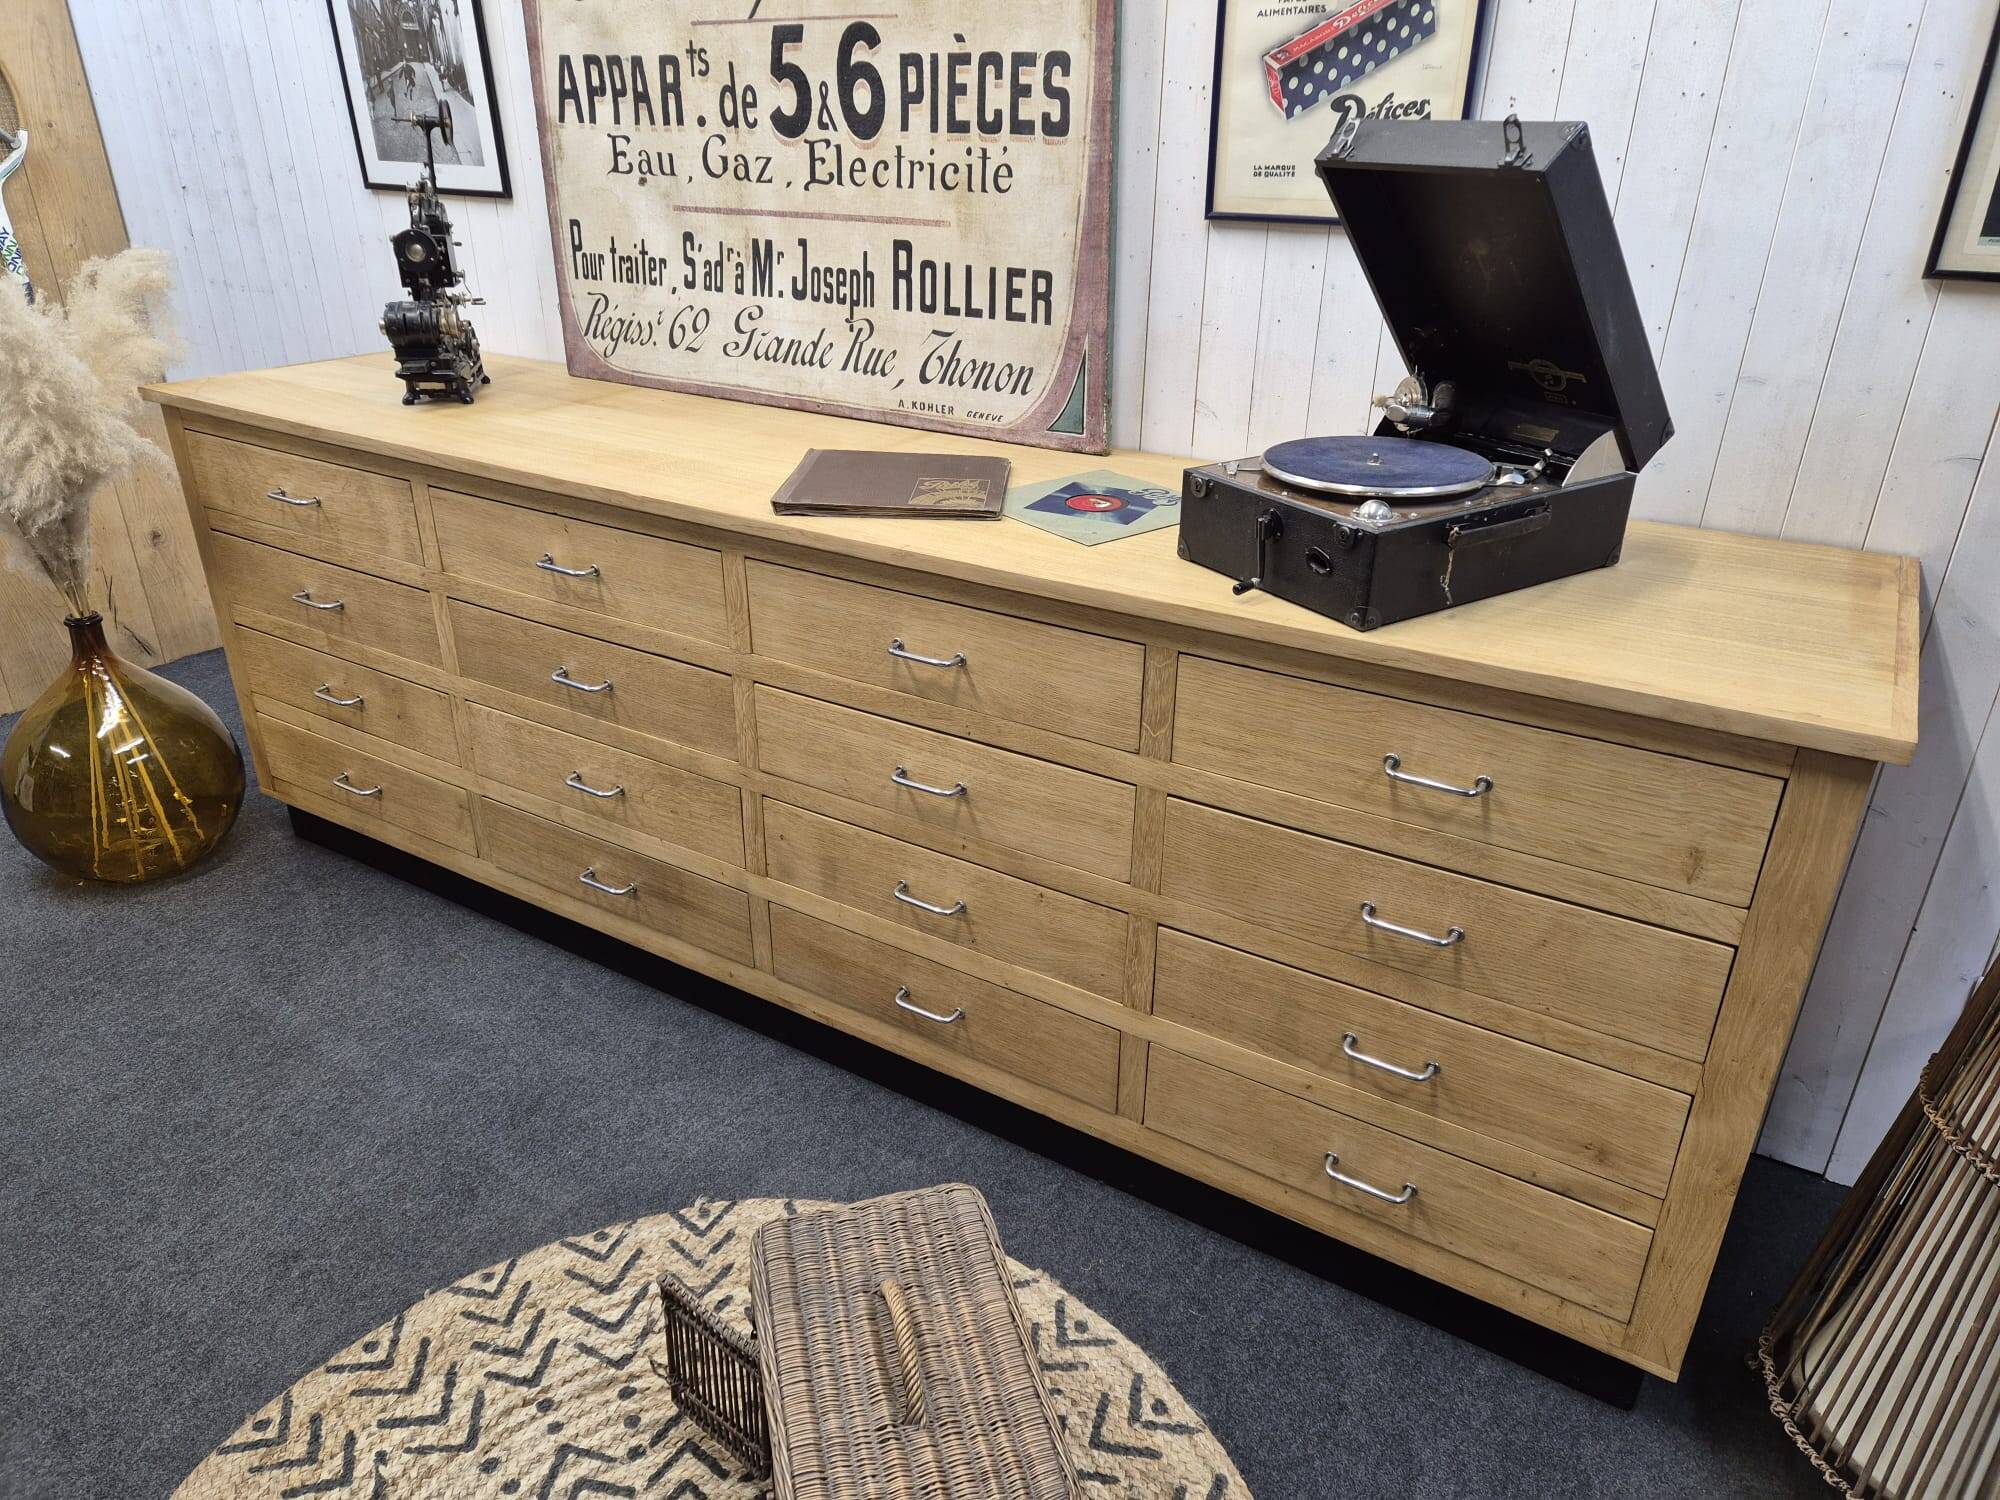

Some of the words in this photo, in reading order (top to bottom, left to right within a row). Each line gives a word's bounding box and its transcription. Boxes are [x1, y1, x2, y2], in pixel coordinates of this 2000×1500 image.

[1257, 5, 1327, 17] ALIMENTAIRES
[719, 61, 758, 129] de
[899, 33, 1072, 138] PIÈCES
[803, 138, 1014, 194] Electricité
[568, 219, 605, 281] Pour
[791, 237, 875, 333] Joseph
[892, 239, 1054, 326] ROLLIER
[668, 305, 711, 353] 62
[722, 304, 835, 370] Grande
[918, 328, 1035, 397] Thonon
